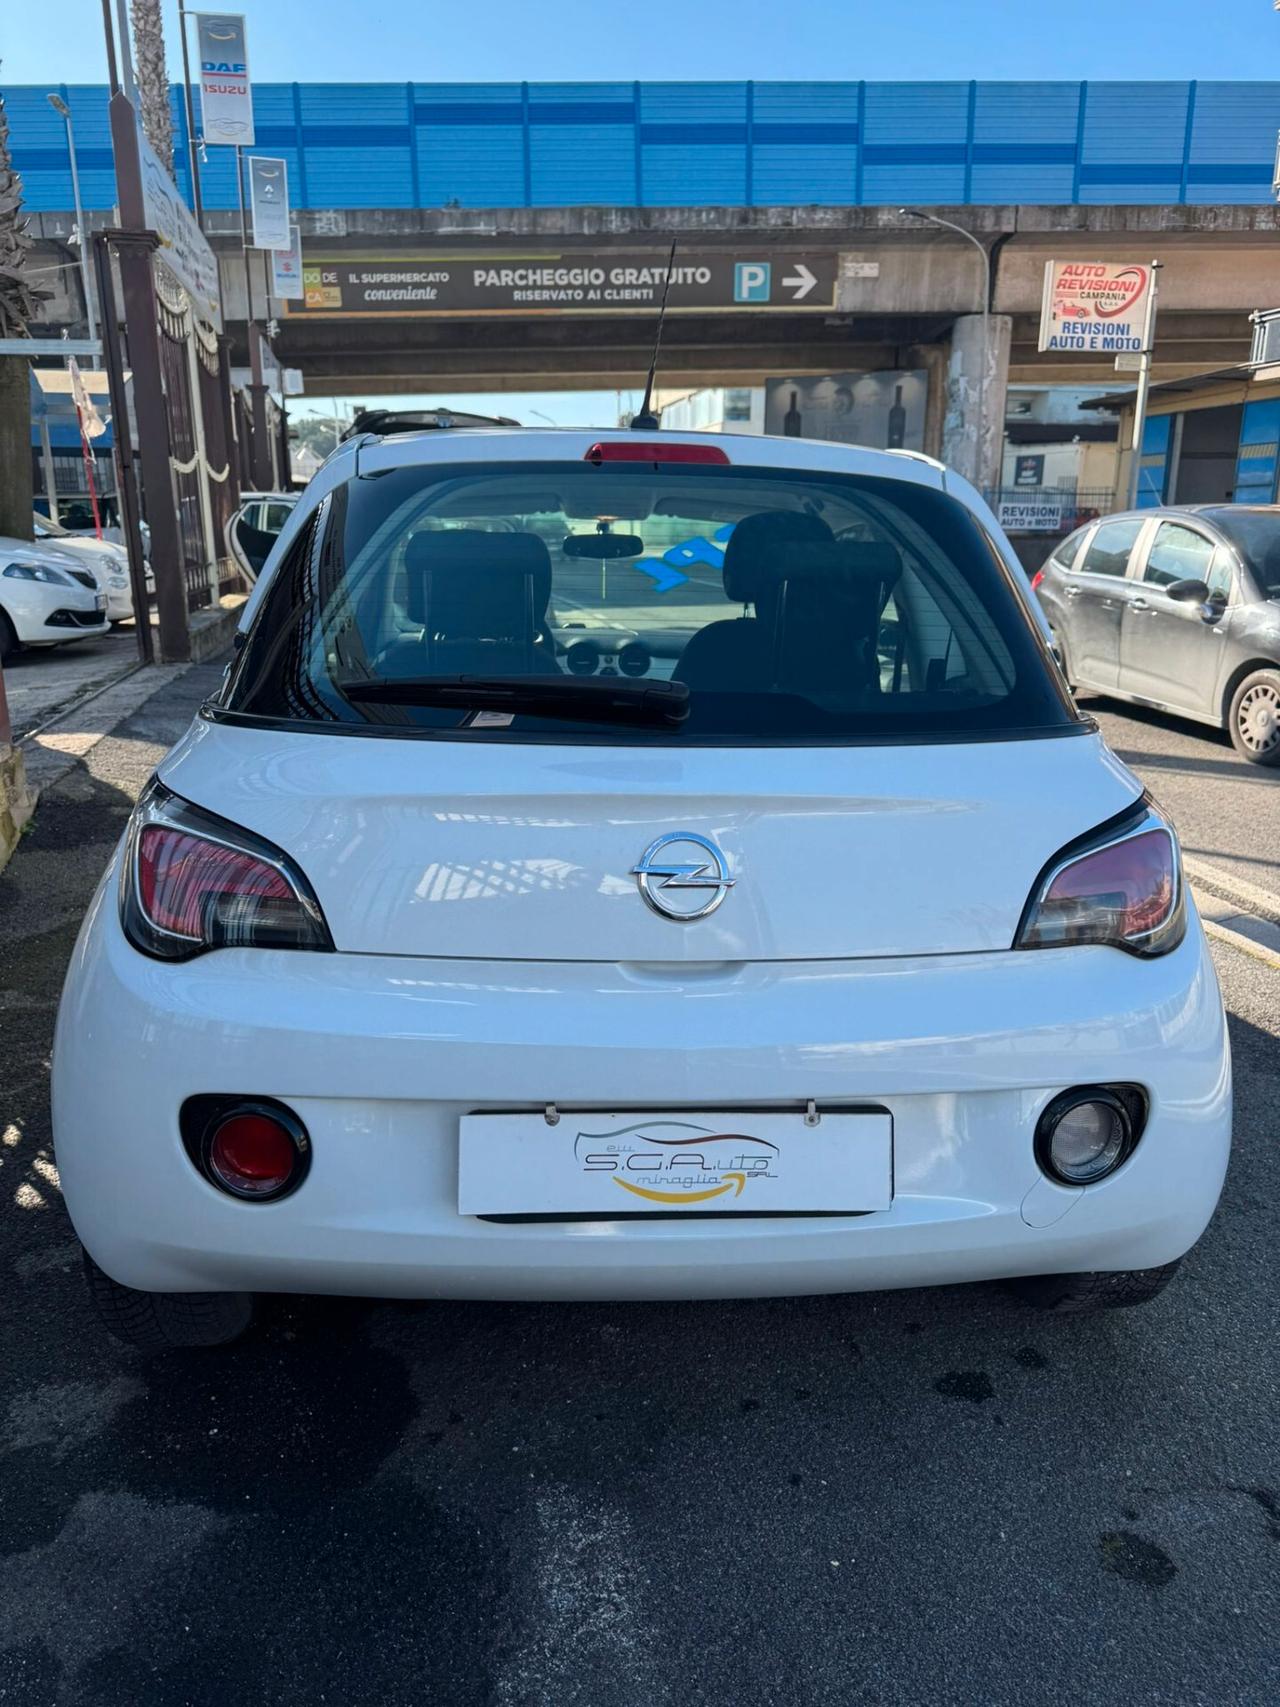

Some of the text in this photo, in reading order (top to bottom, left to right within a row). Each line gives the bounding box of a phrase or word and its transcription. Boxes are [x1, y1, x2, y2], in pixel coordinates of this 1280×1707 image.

[201, 62, 247, 73] DAF
[204, 84, 247, 95] ISUZU
[473, 267, 712, 287] PARCHEGGIO GRATUITO
[1062, 265, 1106, 277] AUTO
[349, 272, 450, 283] IL SUPERMERCATO
[741, 266, 765, 299] P
[1056, 279, 1137, 293] REVISIONI
[364, 286, 438, 301] conveniente
[513, 289, 653, 301] RISERVATO AI CLIENTI
[1080, 291, 1127, 301] CAMPANIA
[1062, 321, 1130, 336] REVISIONI
[1049, 335, 1141, 350] AUTO E MOTO
[1002, 506, 1060, 517] REVISIONI
[1001, 518, 1025, 526] AUTO
[1035, 518, 1059, 526] MOTO
